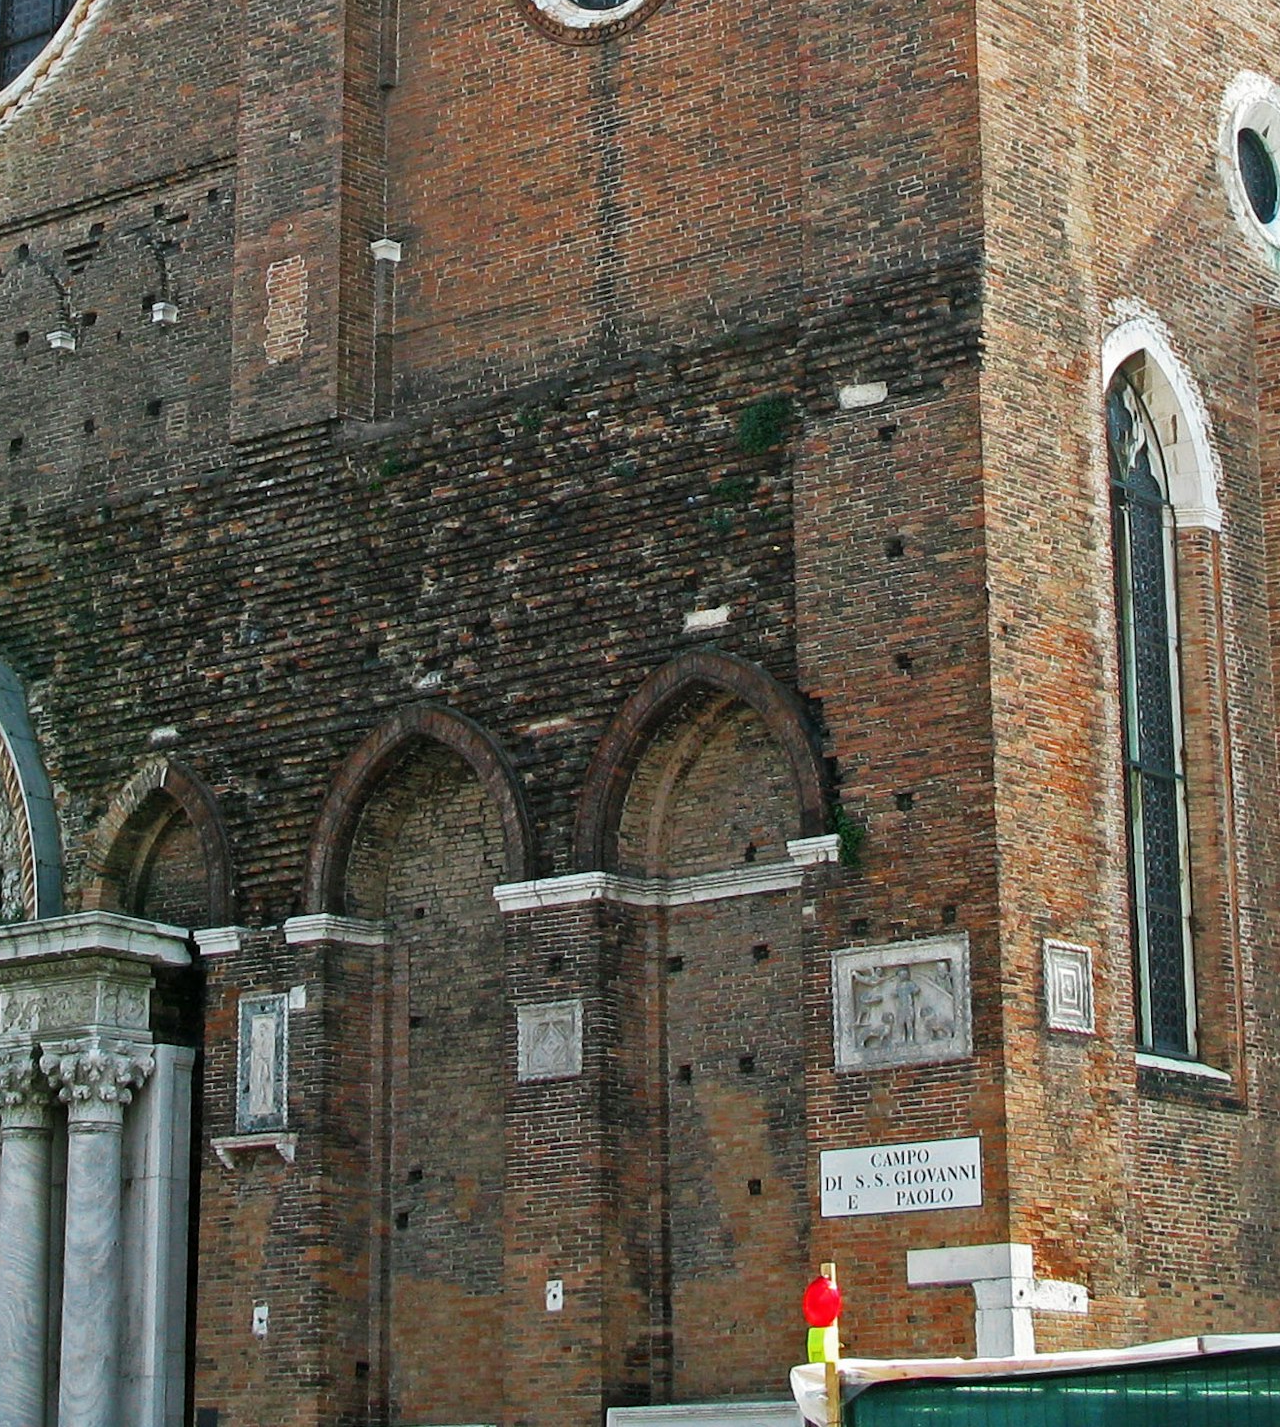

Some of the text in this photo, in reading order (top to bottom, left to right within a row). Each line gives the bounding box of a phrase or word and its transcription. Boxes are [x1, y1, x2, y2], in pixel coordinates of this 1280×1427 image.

[870, 1149, 930, 1168] CAMPO
[825, 1176, 842, 1191] DI
[894, 1164, 976, 1186] GIOVANNI
[848, 1187, 953, 1210] E PAOLO
